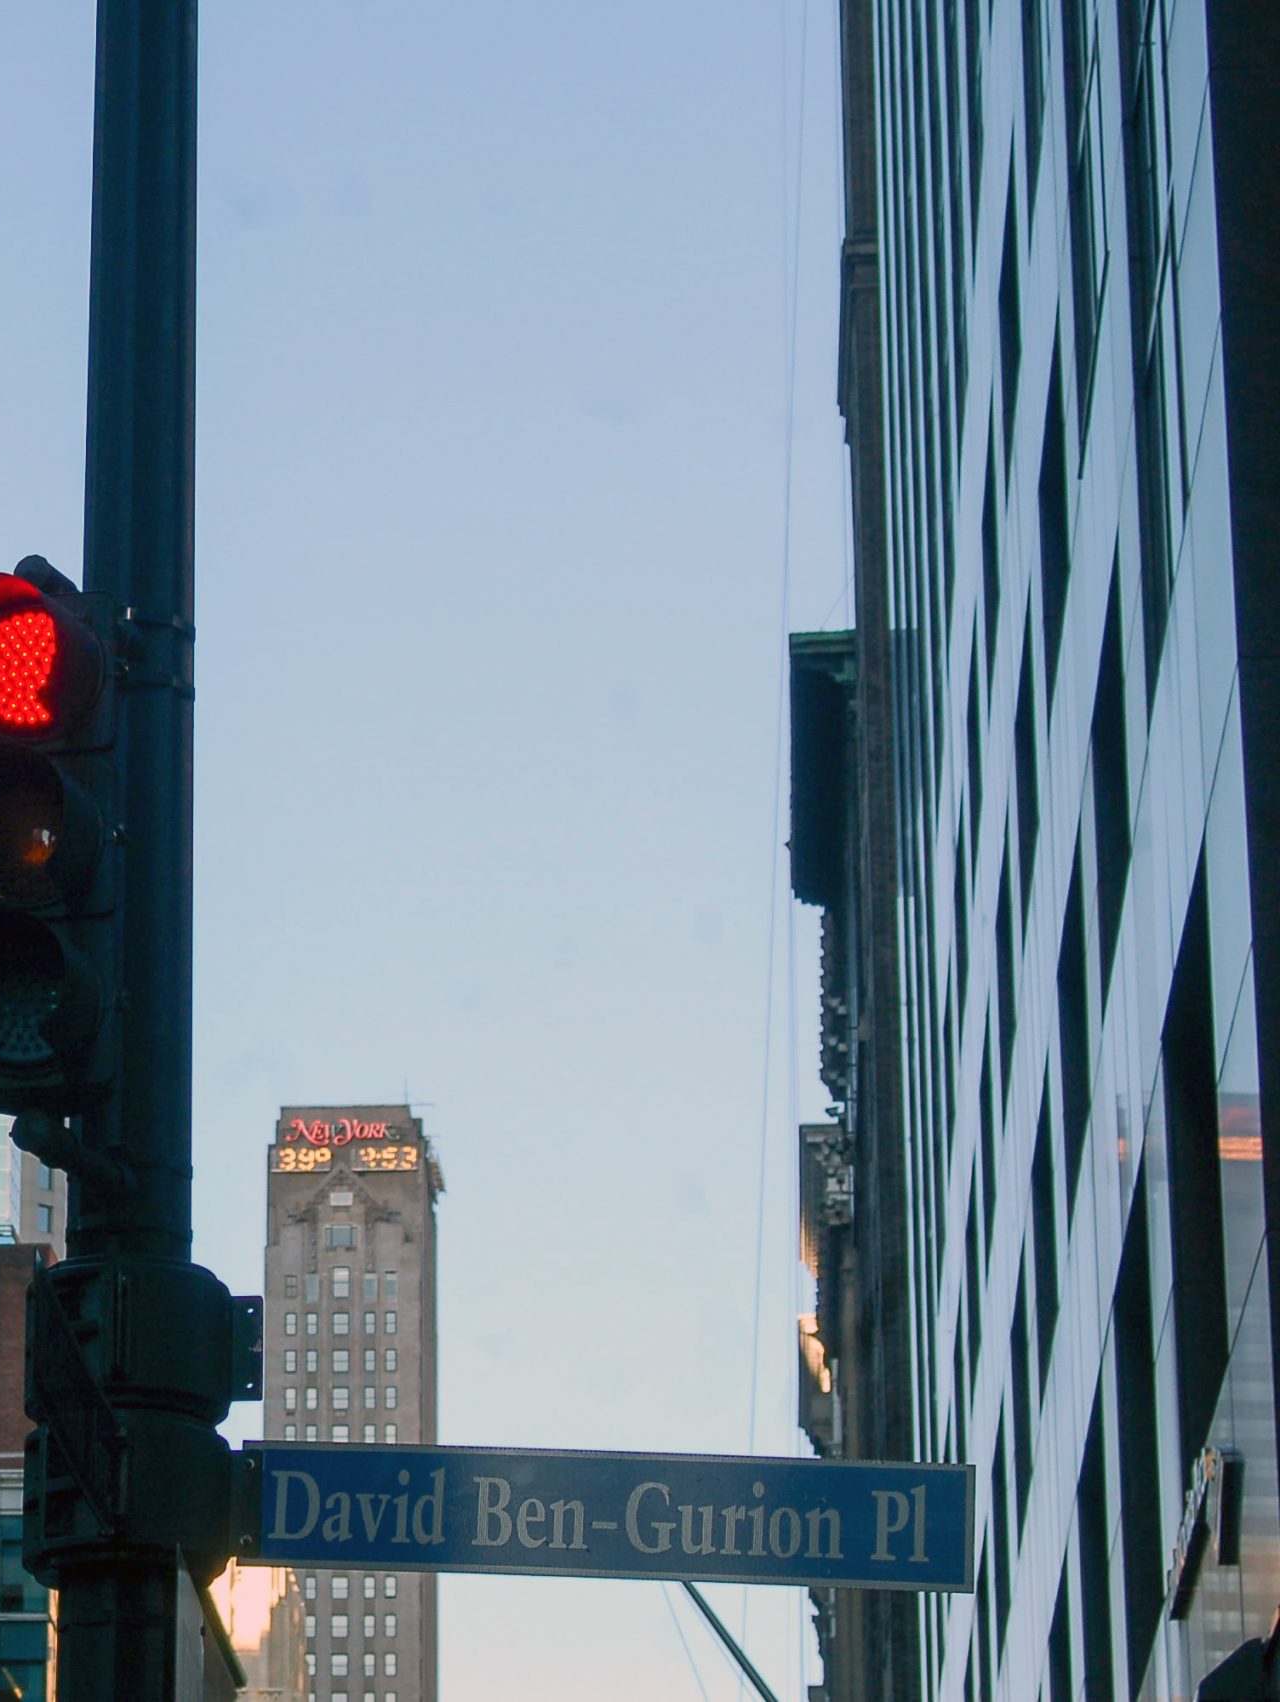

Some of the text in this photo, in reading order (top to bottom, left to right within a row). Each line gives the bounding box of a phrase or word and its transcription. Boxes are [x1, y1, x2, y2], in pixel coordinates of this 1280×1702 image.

[268, 1468, 931, 1563] David Ben-Gurion Pl
